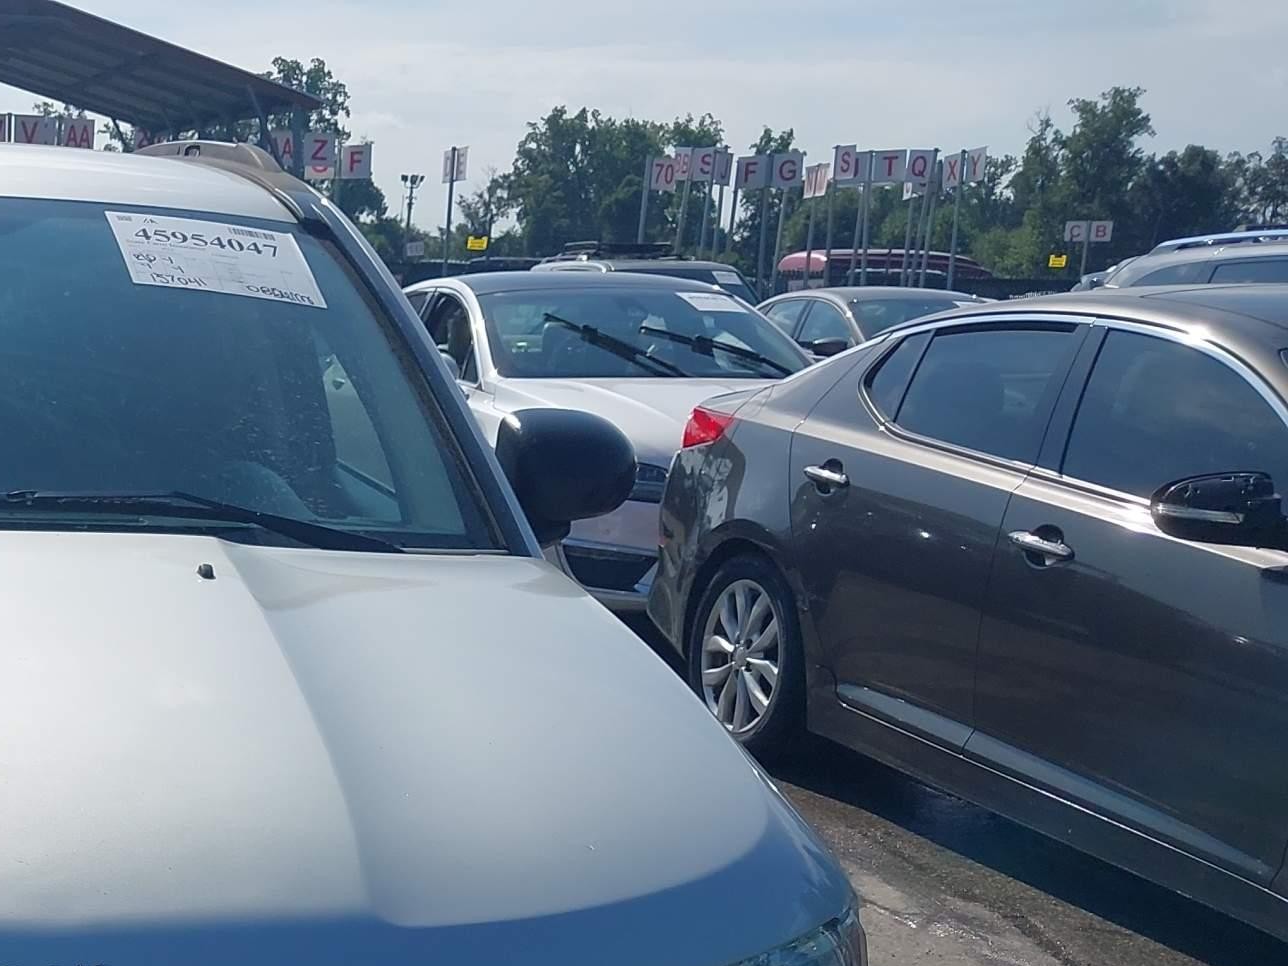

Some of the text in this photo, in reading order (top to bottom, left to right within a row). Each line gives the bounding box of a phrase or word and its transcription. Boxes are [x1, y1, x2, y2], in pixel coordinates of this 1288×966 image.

[21, 120, 39, 144] V
[66, 125, 90, 147] AA
[312, 138, 329, 161] Z
[349, 150, 364, 173] F
[700, 153, 712, 175] S
[744, 161, 759, 183] F
[779, 159, 797, 181] G
[840, 151, 852, 173] S
[883, 155, 899, 177] T
[912, 155, 928, 178] Q
[947, 159, 958, 181] X
[970, 153, 982, 177] Y
[655, 163, 674, 185] 70
[1095, 224, 1107, 238] B
[135, 227, 278, 258] 45954047
